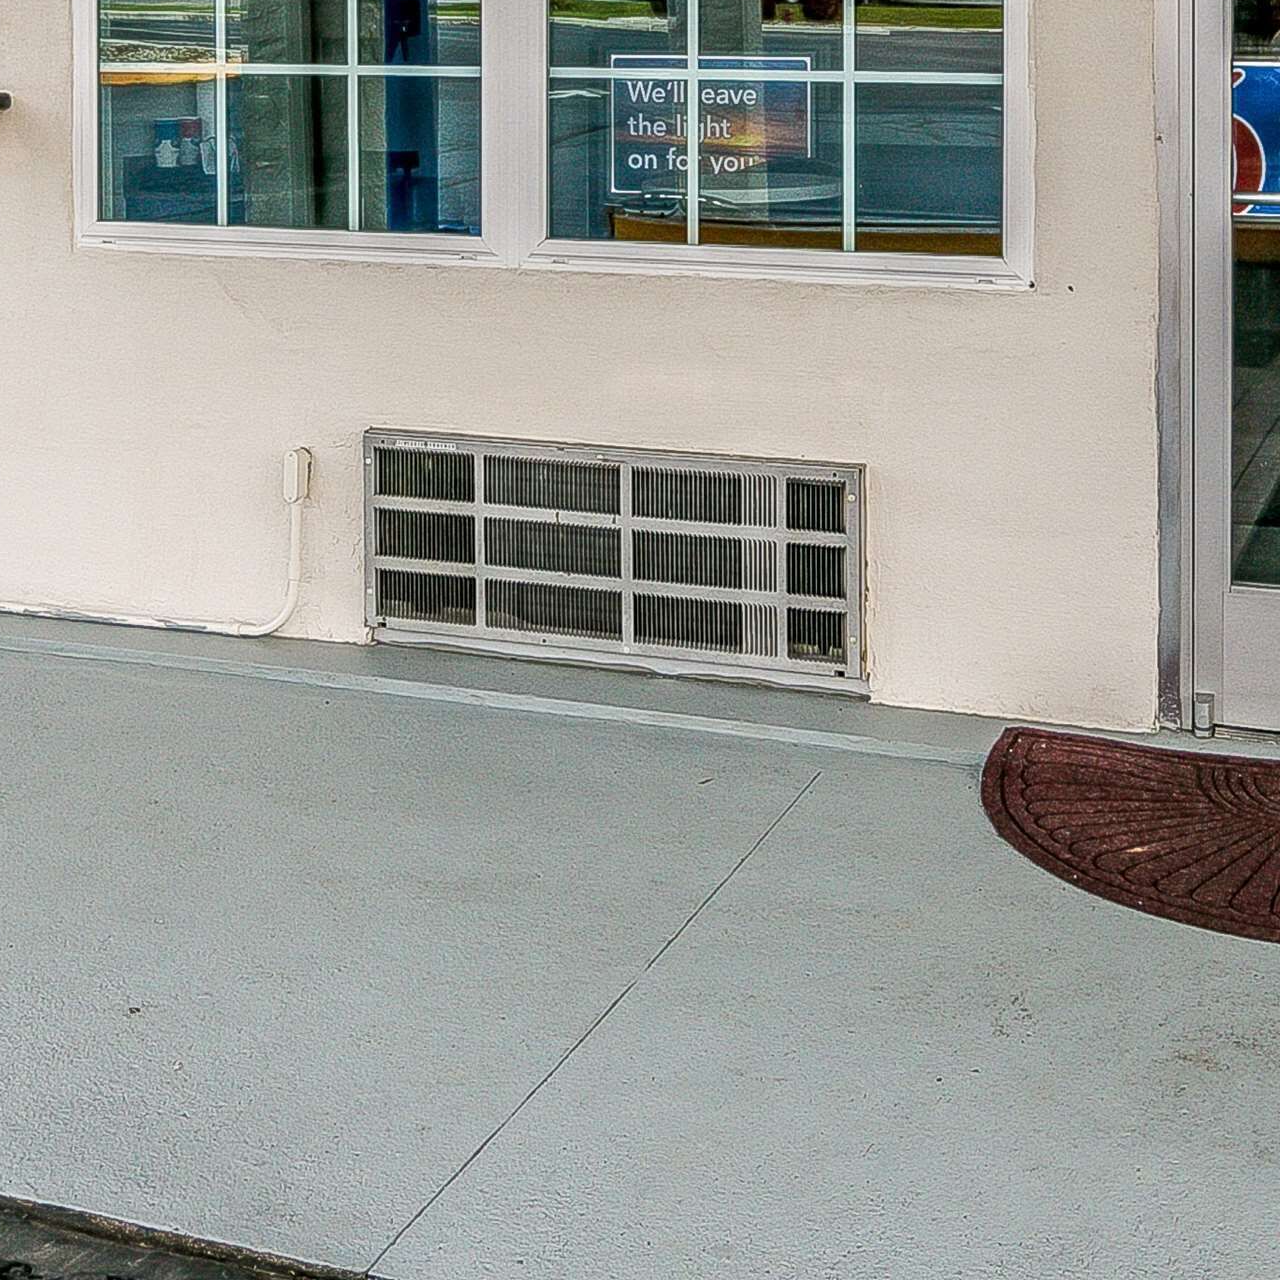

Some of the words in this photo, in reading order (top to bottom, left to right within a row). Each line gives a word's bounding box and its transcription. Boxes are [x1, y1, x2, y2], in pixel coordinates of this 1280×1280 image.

[698, 86, 757, 105] eave
[627, 113, 667, 136] the
[628, 153, 657, 170] on
[666, 147, 701, 170] fo
